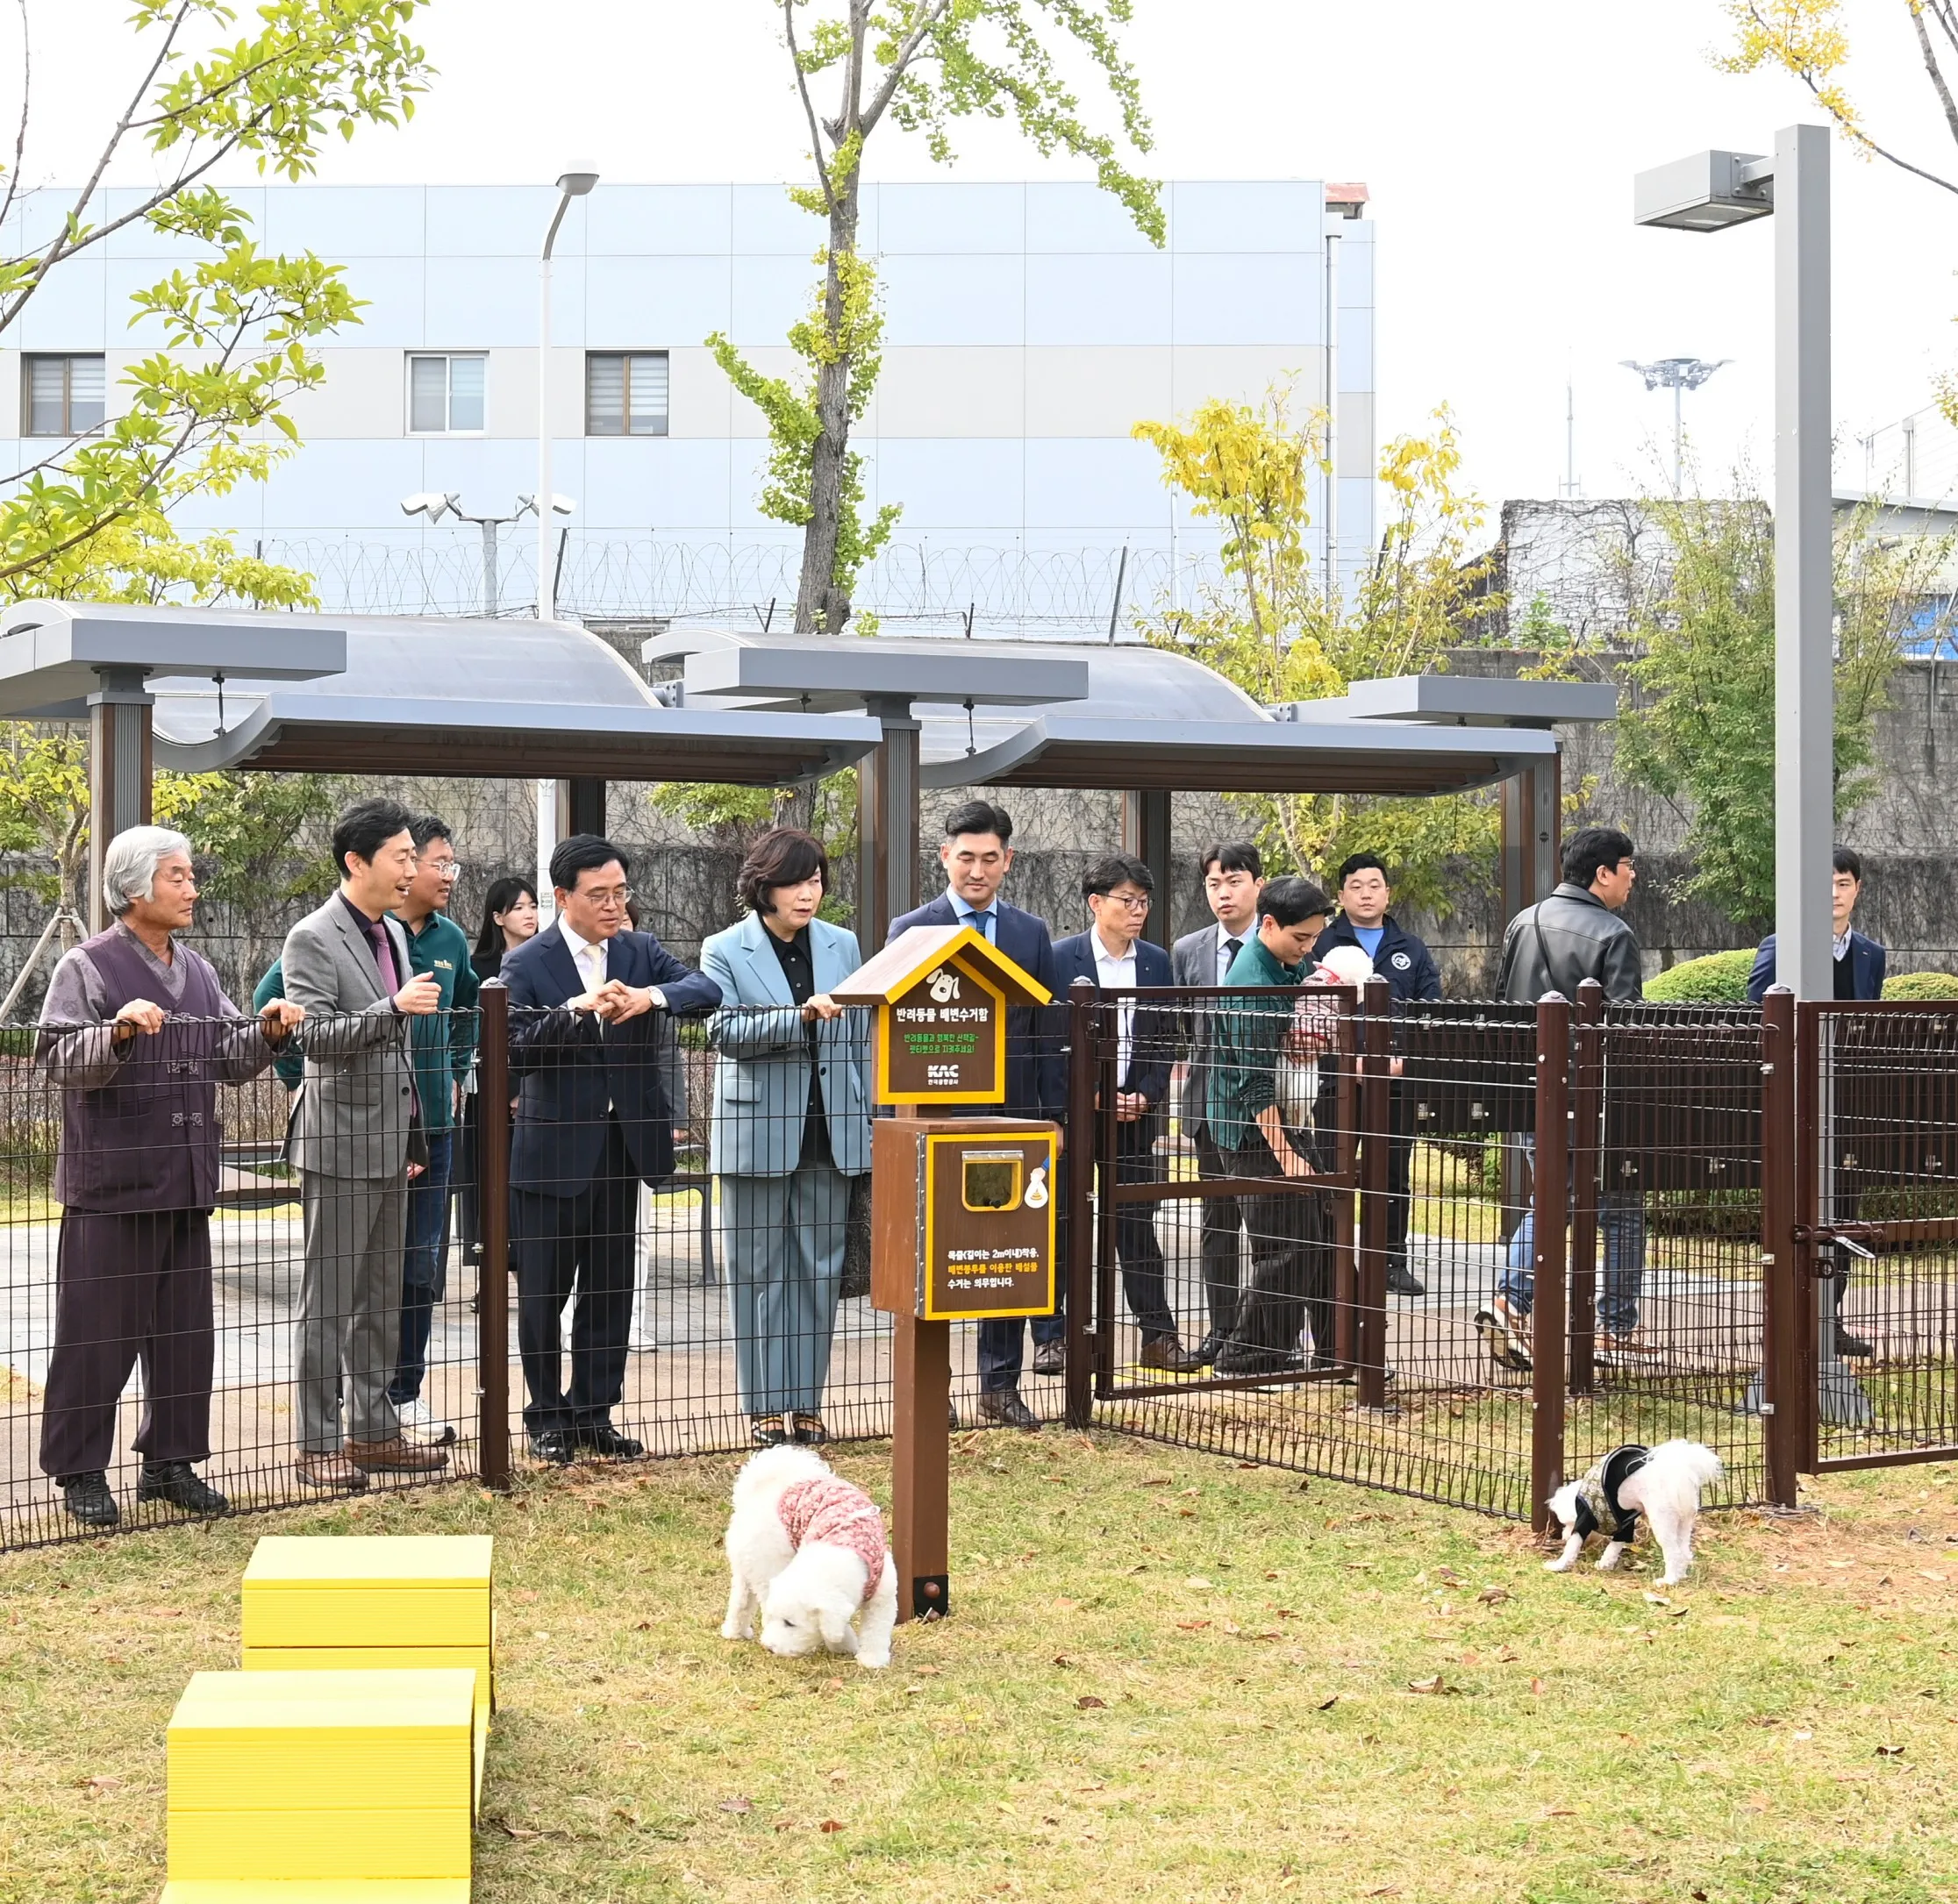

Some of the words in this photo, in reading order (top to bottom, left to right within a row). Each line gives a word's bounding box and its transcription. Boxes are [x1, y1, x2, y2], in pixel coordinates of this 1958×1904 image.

[897, 1008, 936, 1022] 반려동물
[940, 1008, 989, 1022] 배변수거함
[904, 1033, 935, 1043] 반려동물과
[937, 1033, 954, 1043] 행복한
[910, 1045, 940, 1054] 펫티켓으로
[942, 1045, 975, 1053] 지켜주세요!
[927, 1065, 959, 1077] KAC
[947, 1250, 990, 1260] 목줄(길이는
[947, 1264, 987, 1274] 배변봉투를
[990, 1263, 1012, 1273] 이용한
[1015, 1262, 1038, 1273] 배설물
[947, 1279, 971, 1289] 수거는
[974, 1277, 1014, 1288] 의무입니다.
